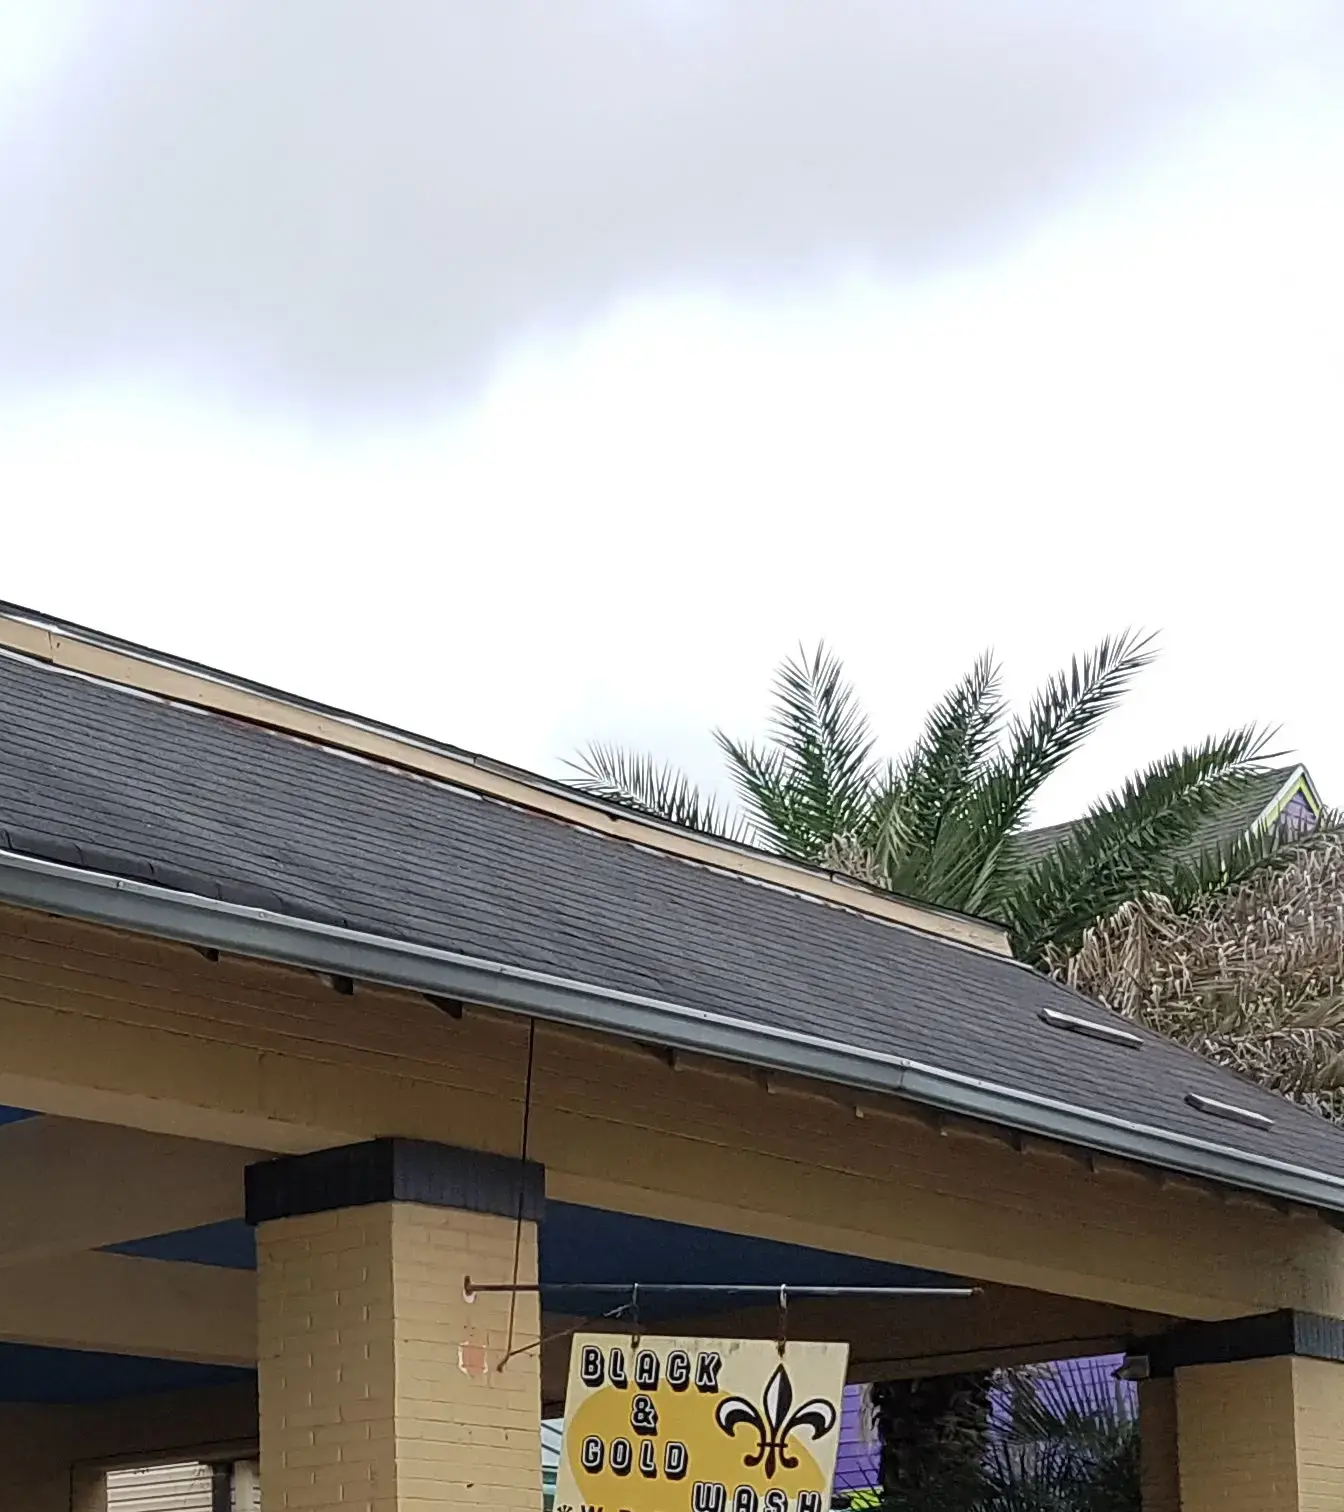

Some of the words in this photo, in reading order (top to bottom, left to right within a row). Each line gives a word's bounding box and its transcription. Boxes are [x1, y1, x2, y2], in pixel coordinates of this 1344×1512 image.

[580, 1345, 722, 1392] BLACK
[631, 1394, 657, 1435] &
[580, 1436, 689, 1480] GOLD
